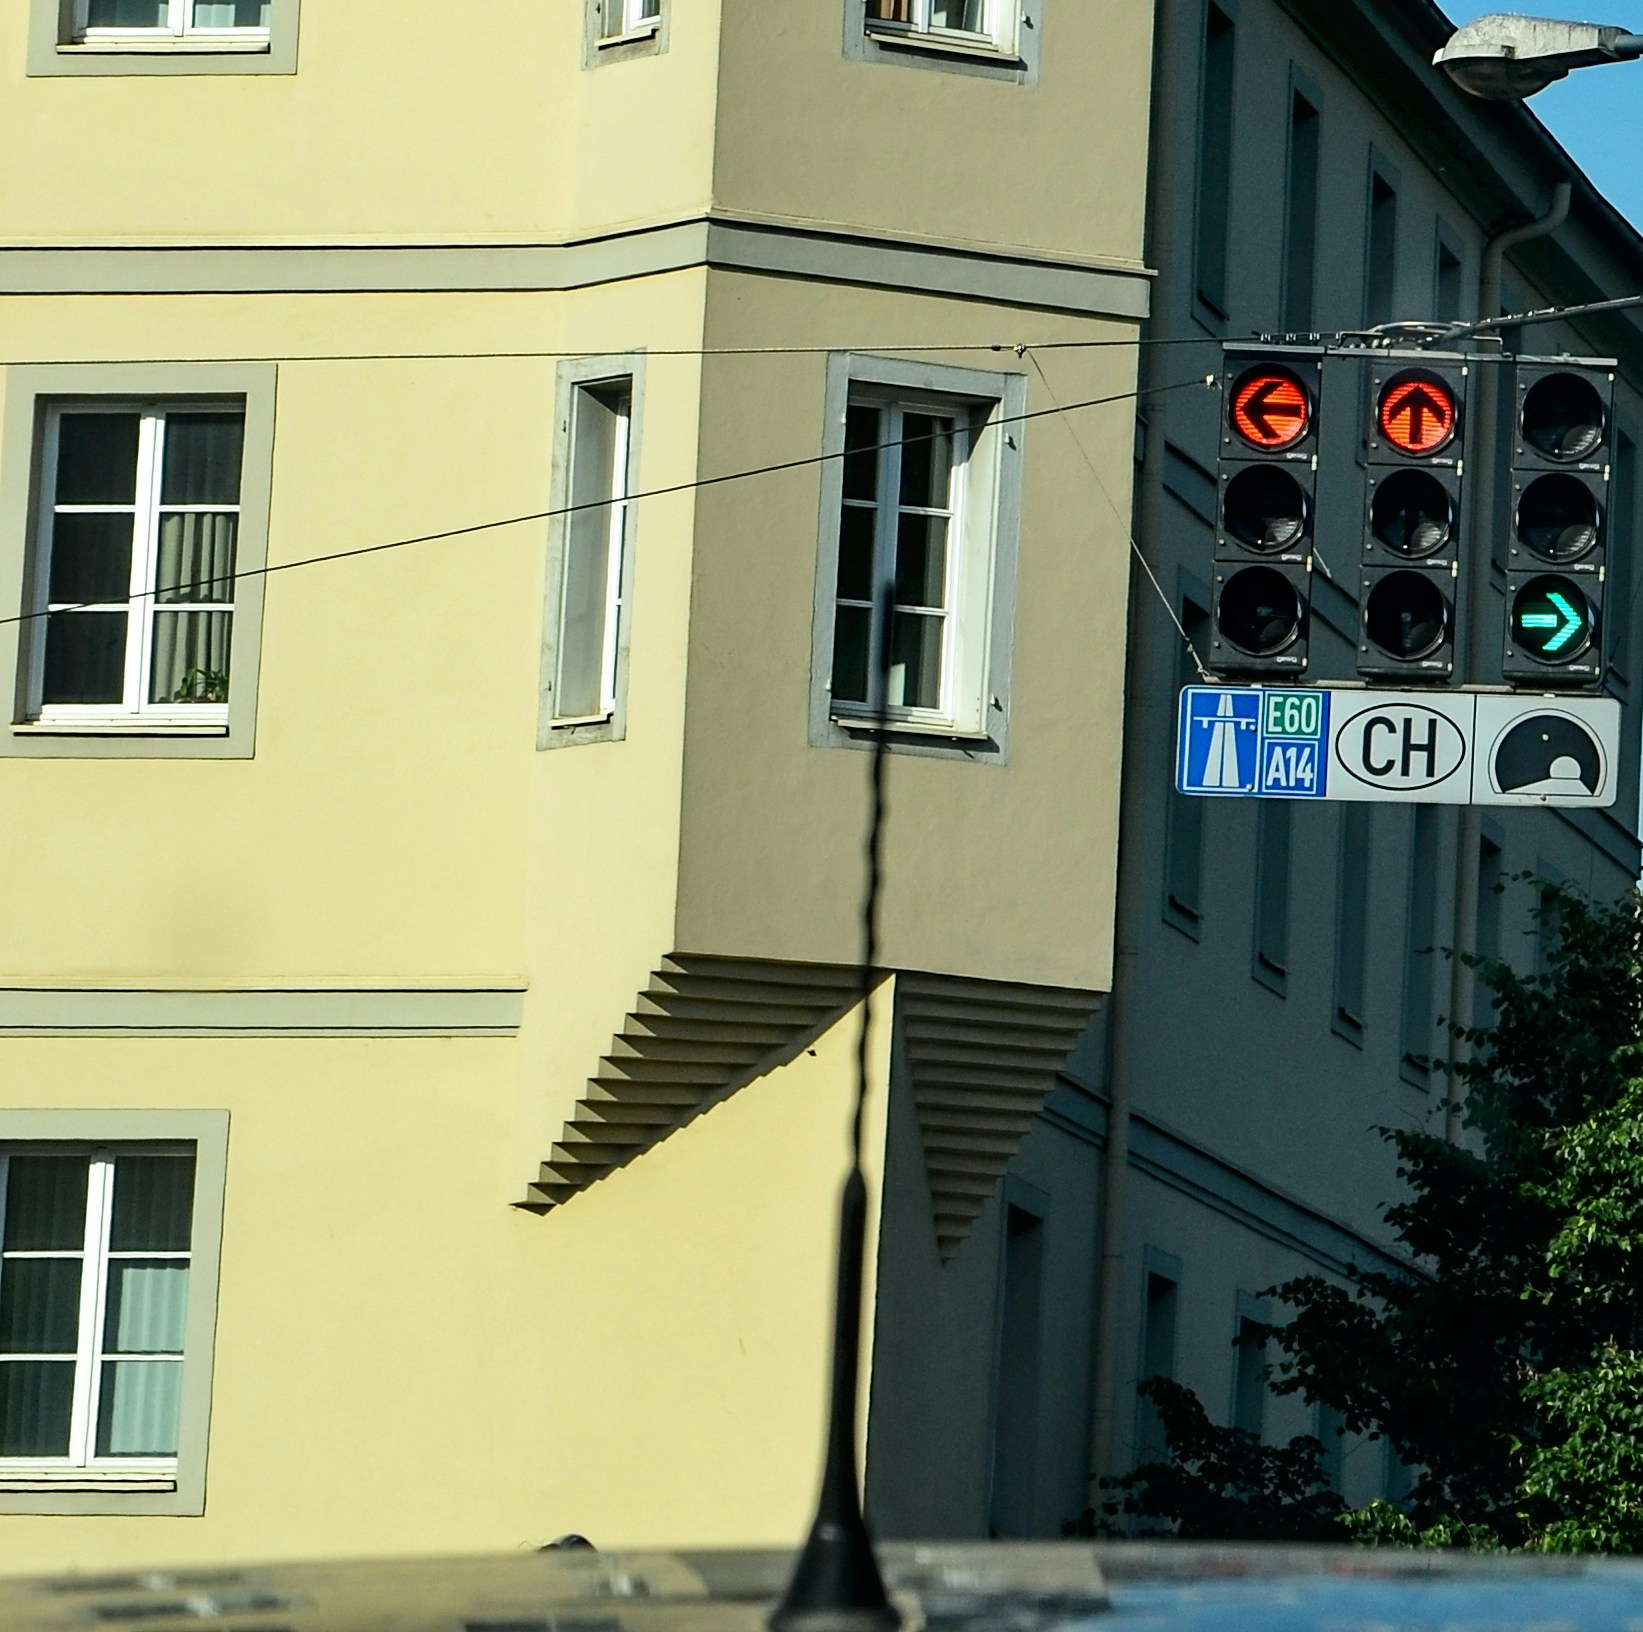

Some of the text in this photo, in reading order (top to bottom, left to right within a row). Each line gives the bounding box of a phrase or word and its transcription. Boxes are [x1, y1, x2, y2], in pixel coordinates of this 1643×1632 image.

[1267, 696, 1318, 734] E60
[1266, 745, 1315, 788] A14
[1361, 715, 1438, 778] CH
